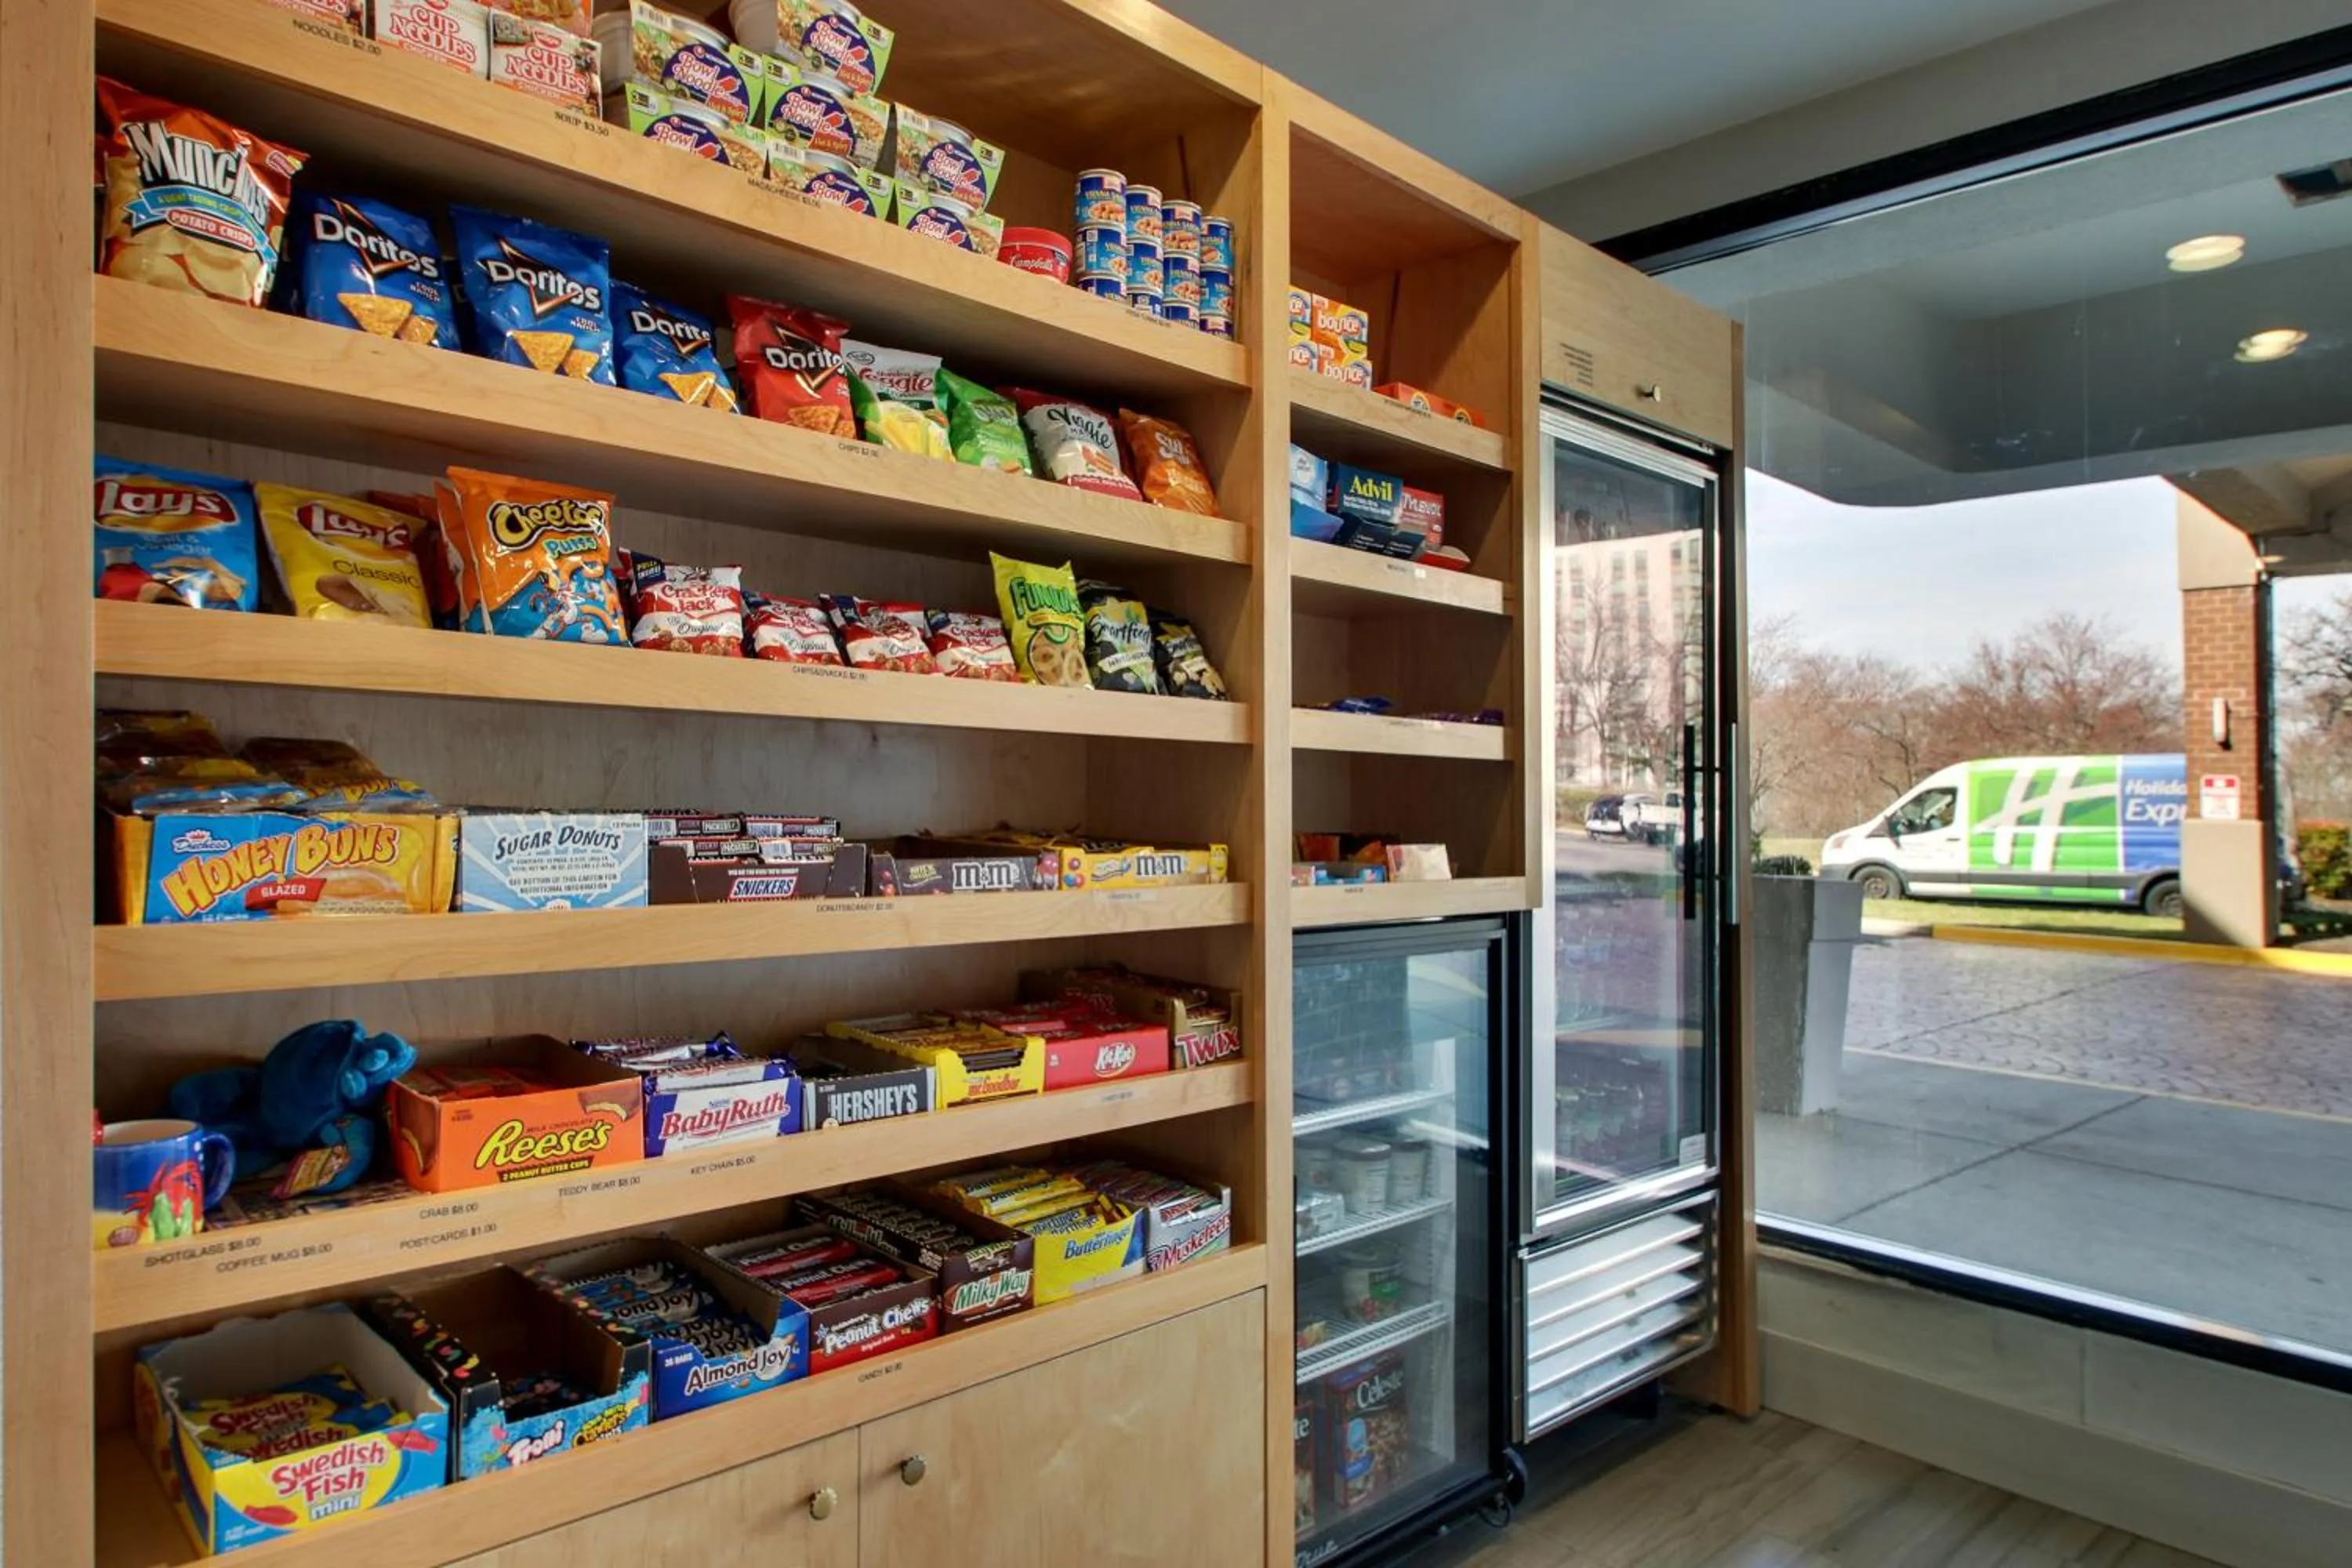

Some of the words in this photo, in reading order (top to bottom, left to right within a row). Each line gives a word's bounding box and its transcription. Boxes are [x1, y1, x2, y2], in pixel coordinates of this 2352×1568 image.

[292, 19, 350, 47] NOODLES
[412, 5, 459, 34] CUP
[526, 46, 574, 74] CUP
[679, 52, 720, 79] Bowl
[554, 111, 581, 129] SOUP
[172, 212, 217, 234] POTATO
[315, 213, 440, 278] Doritos
[489, 260, 603, 309] Doritos
[1317, 310, 1359, 333] bounce
[1047, 407, 1112, 449] Veggie
[99, 481, 223, 517] Lay's
[1350, 476, 1393, 503] Advil
[311, 503, 409, 550] Lay's
[489, 499, 605, 547] Cheetos
[332, 560, 421, 590] Classic
[661, 584, 730, 599] Cracker
[672, 597, 717, 613] Jack
[2125, 779, 2186, 796] Holida
[495, 830, 552, 861] SUGAR
[557, 825, 622, 851] DONUTS
[163, 834, 290, 916] HONEY
[296, 823, 398, 877] BUNS
[260, 884, 307, 898] GLAZED
[732, 877, 795, 896] SNICKERS
[831, 1083, 918, 1123] HERSHEY'S
[474, 1119, 613, 1170] Reese's
[510, 1168, 539, 1181] PEANUT
[540, 1163, 569, 1176] BUTTER
[570, 1160, 590, 1171] CUPS
[691, 1164, 706, 1174] KEY
[709, 1160, 734, 1173] CHAIN
[558, 1185, 588, 1198] TEDDY
[591, 1180, 615, 1192] BEAR
[419, 1207, 449, 1220] CRAB
[470, 1222, 497, 1237] $1.00
[144, 1242, 225, 1268] SHOTGLASS
[216, 1256, 267, 1274] COFFEE
[270, 1249, 301, 1264] MUG
[953, 1275, 998, 1312] Milky
[999, 1269, 1032, 1298] Way
[825, 1316, 881, 1355] Peanut
[882, 1298, 931, 1329] Chews
[685, 1354, 758, 1396] Almond
[759, 1344, 789, 1374] Joy
[506, 1420, 565, 1466] Trolli
[271, 1441, 387, 1496] Swedish
[302, 1469, 365, 1504] Fish
[311, 1495, 361, 1521] mini
